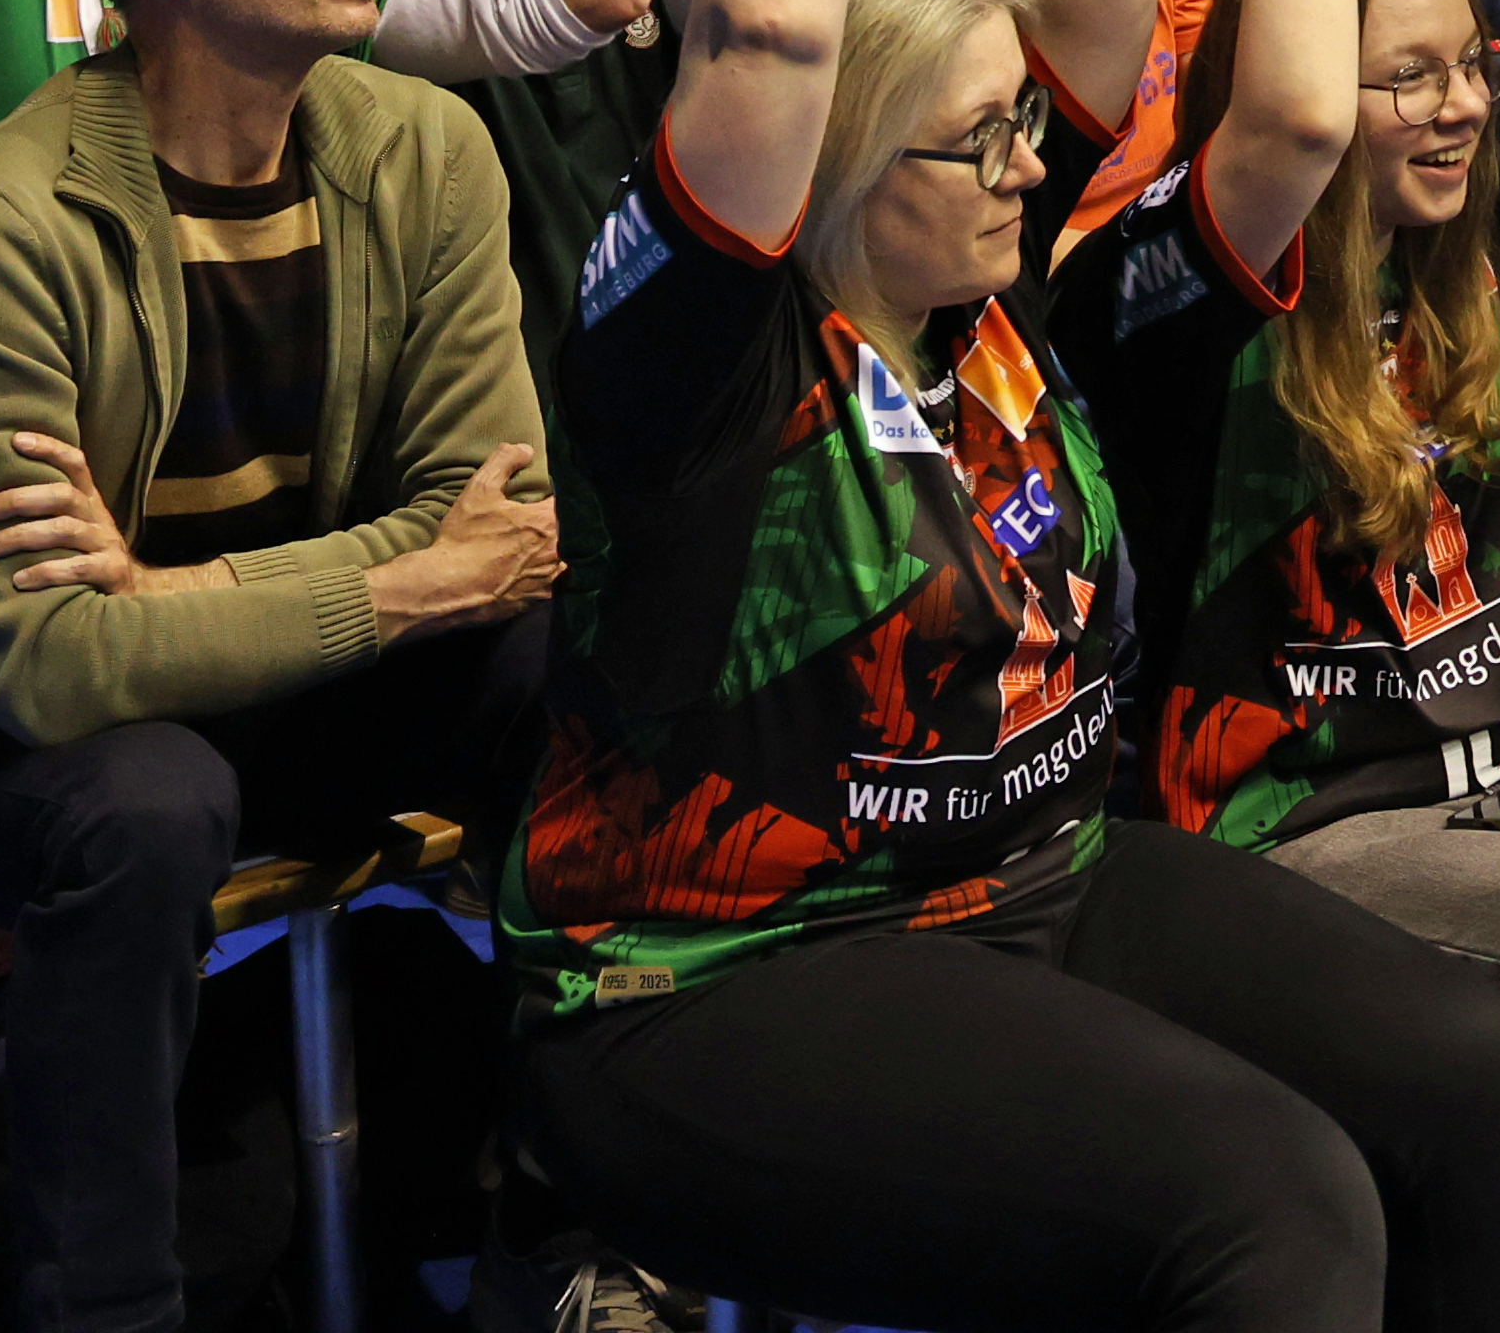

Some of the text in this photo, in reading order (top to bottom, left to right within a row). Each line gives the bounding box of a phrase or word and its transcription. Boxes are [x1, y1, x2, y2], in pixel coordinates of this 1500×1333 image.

[872, 419, 905, 440] Das
[1285, 663, 1357, 698] WIR
[849, 781, 930, 823] WIR
[946, 787, 993, 821] für
[602, 974, 628, 990] 1955
[638, 974, 671, 990] 2025
